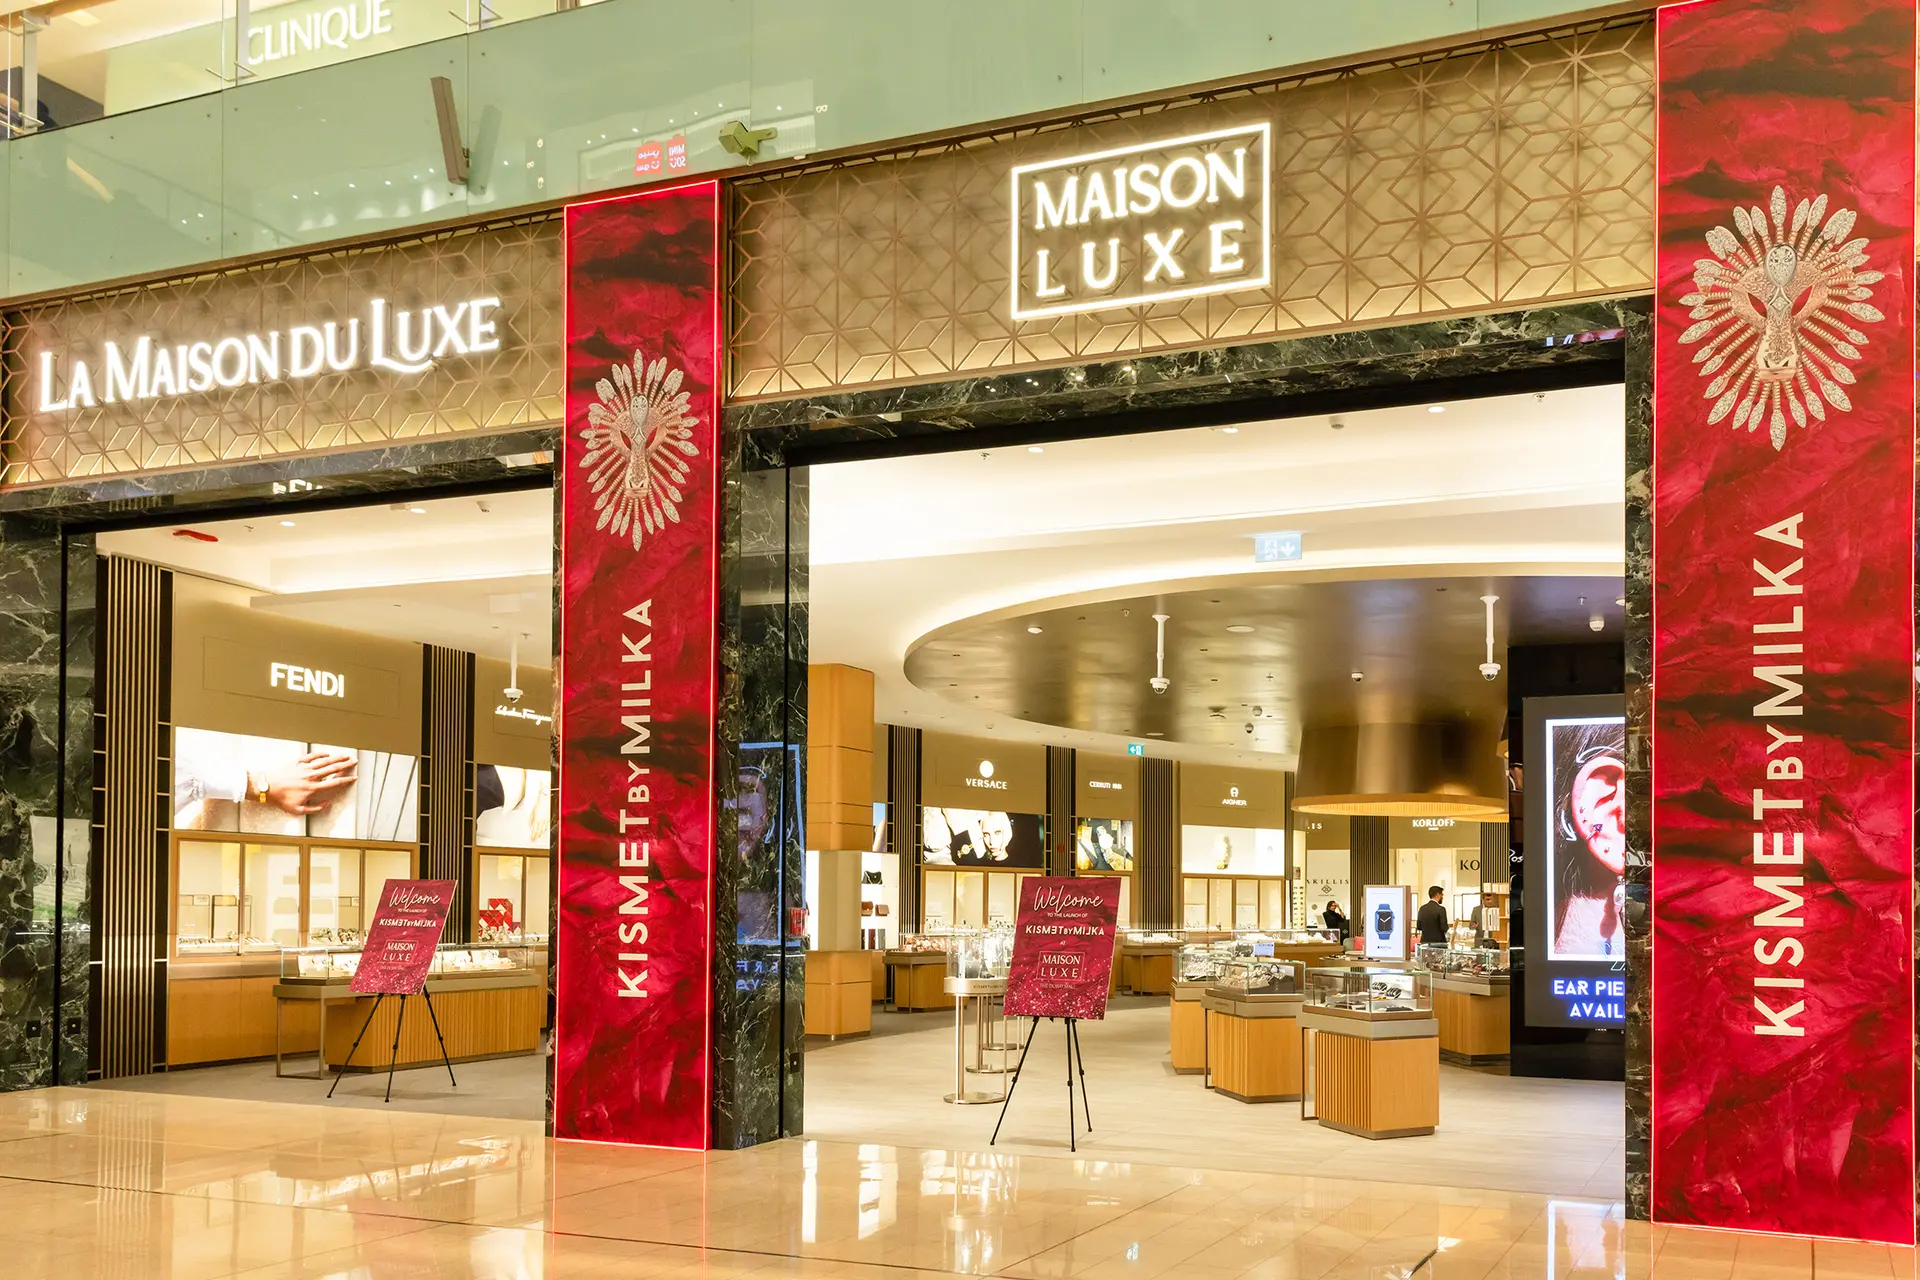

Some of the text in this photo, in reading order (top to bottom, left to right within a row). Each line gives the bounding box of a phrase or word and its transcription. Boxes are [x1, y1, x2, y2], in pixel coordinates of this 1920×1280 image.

[248, 0, 392, 65] CLINIQUE
[1034, 148, 1246, 229] MAISON
[1036, 221, 1244, 297] LUXE
[39, 298, 501, 411] LA MAISON DU LUXE
[271, 662, 344, 698] FENDI
[966, 778, 1007, 789] VERSACE
[1412, 818, 1455, 827] KORLOFF
[389, 887, 440, 908] Welcome
[1034, 886, 1103, 912] Welcome
[387, 942, 415, 951] MAISON
[383, 953, 411, 961] LUXE
[1042, 955, 1080, 964] MAISON
[1041, 968, 1078, 977] LUXE
[1554, 980, 1588, 995] EAR
[1569, 1003, 1625, 1018] AVAIL
